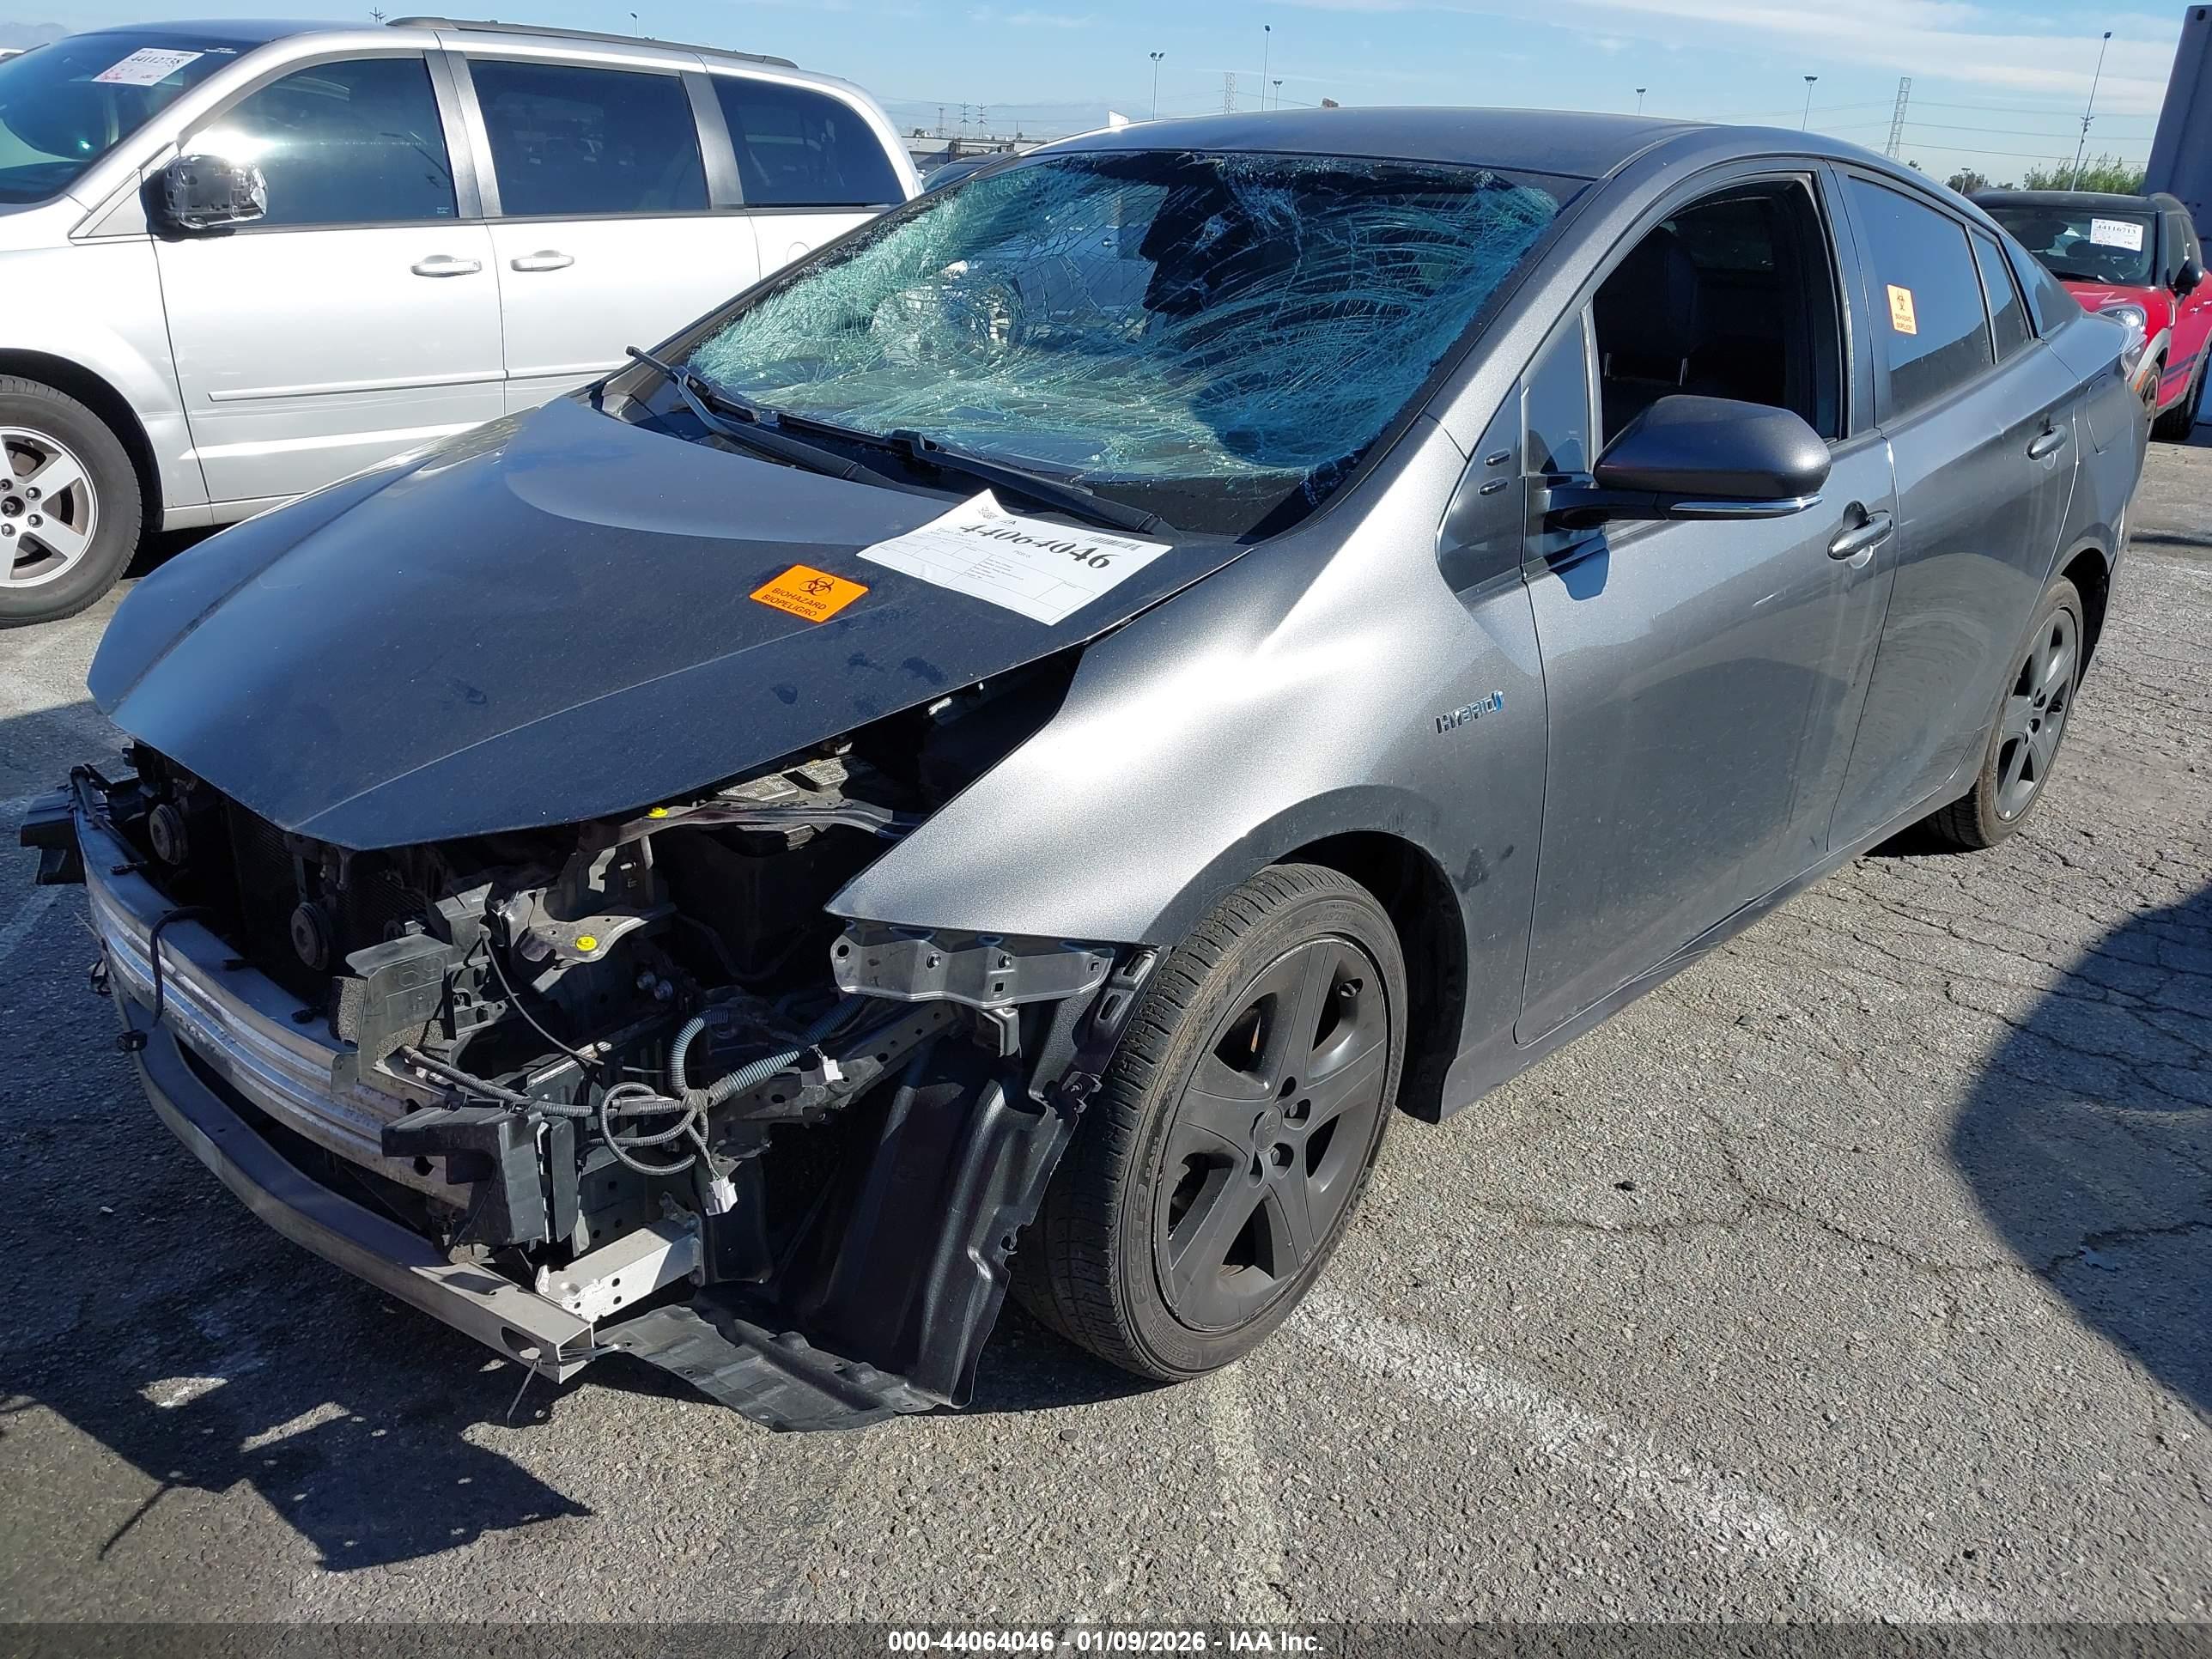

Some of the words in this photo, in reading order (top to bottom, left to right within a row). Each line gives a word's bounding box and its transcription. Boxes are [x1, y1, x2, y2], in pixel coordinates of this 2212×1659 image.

[958, 525, 1120, 569] 44064046
[761, 593, 817, 617] BIOPELIGRO
[771, 587, 828, 611] BIOHAZARD
[1436, 690, 1504, 734] HYBRID
